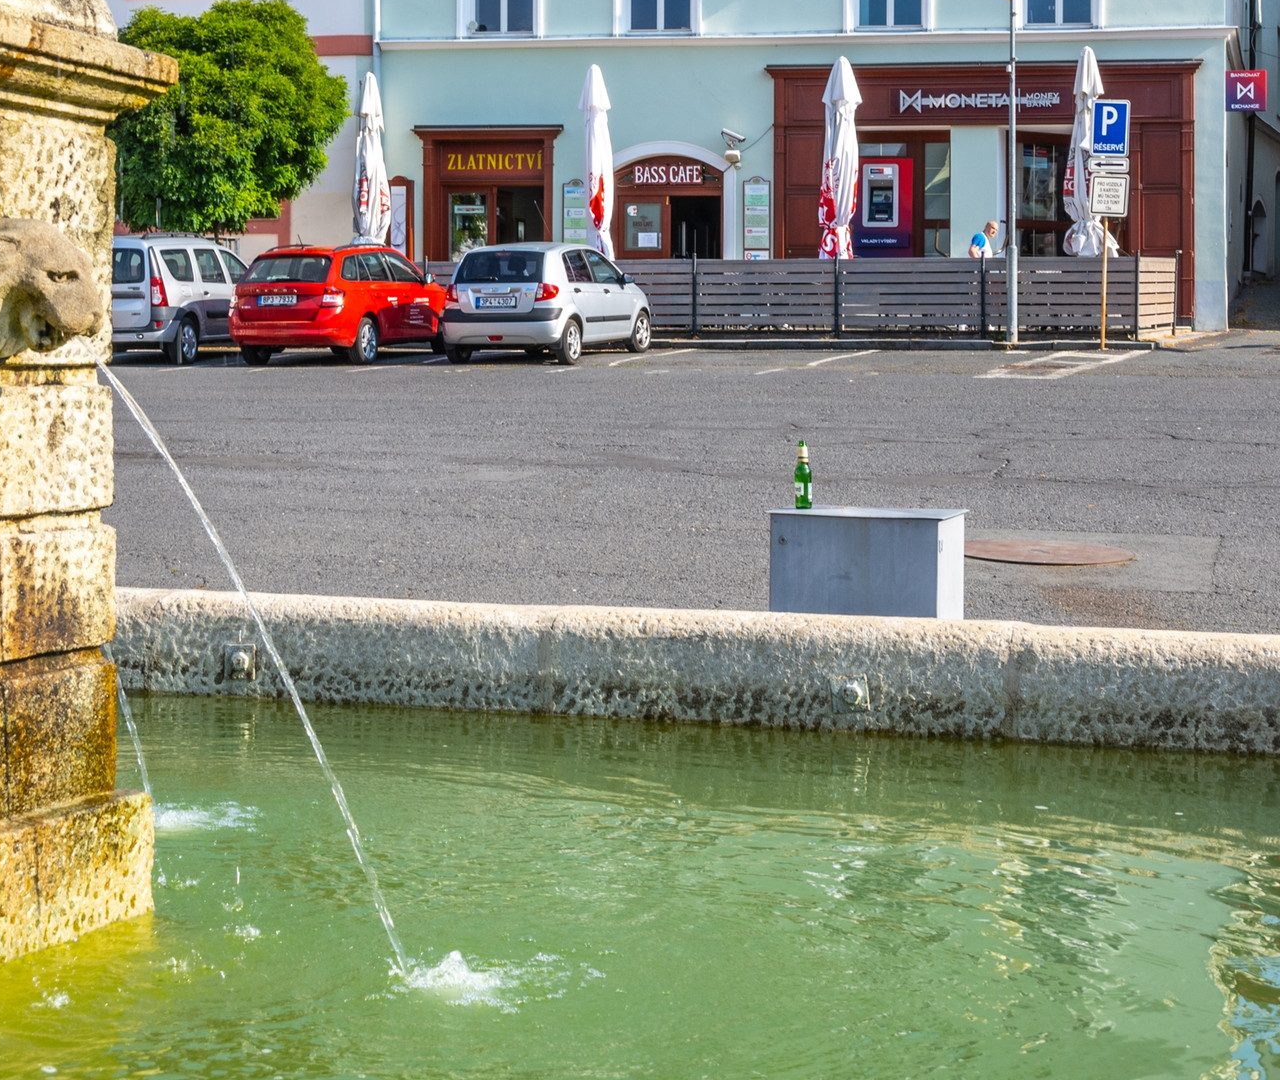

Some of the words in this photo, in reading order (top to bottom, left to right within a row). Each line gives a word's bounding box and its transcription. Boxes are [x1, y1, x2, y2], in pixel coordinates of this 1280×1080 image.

[928, 93, 1010, 109] MONETA
[1025, 92, 1060, 100] MONEY
[1026, 100, 1053, 108] BANK
[1102, 106, 1118, 136] P
[1093, 142, 1124, 151] RÉSERVÉ
[447, 150, 543, 170] ZLATNICTVÍ
[635, 166, 667, 184] BASS
[669, 165, 701, 183] CAFE
[278, 295, 294, 303] 7932
